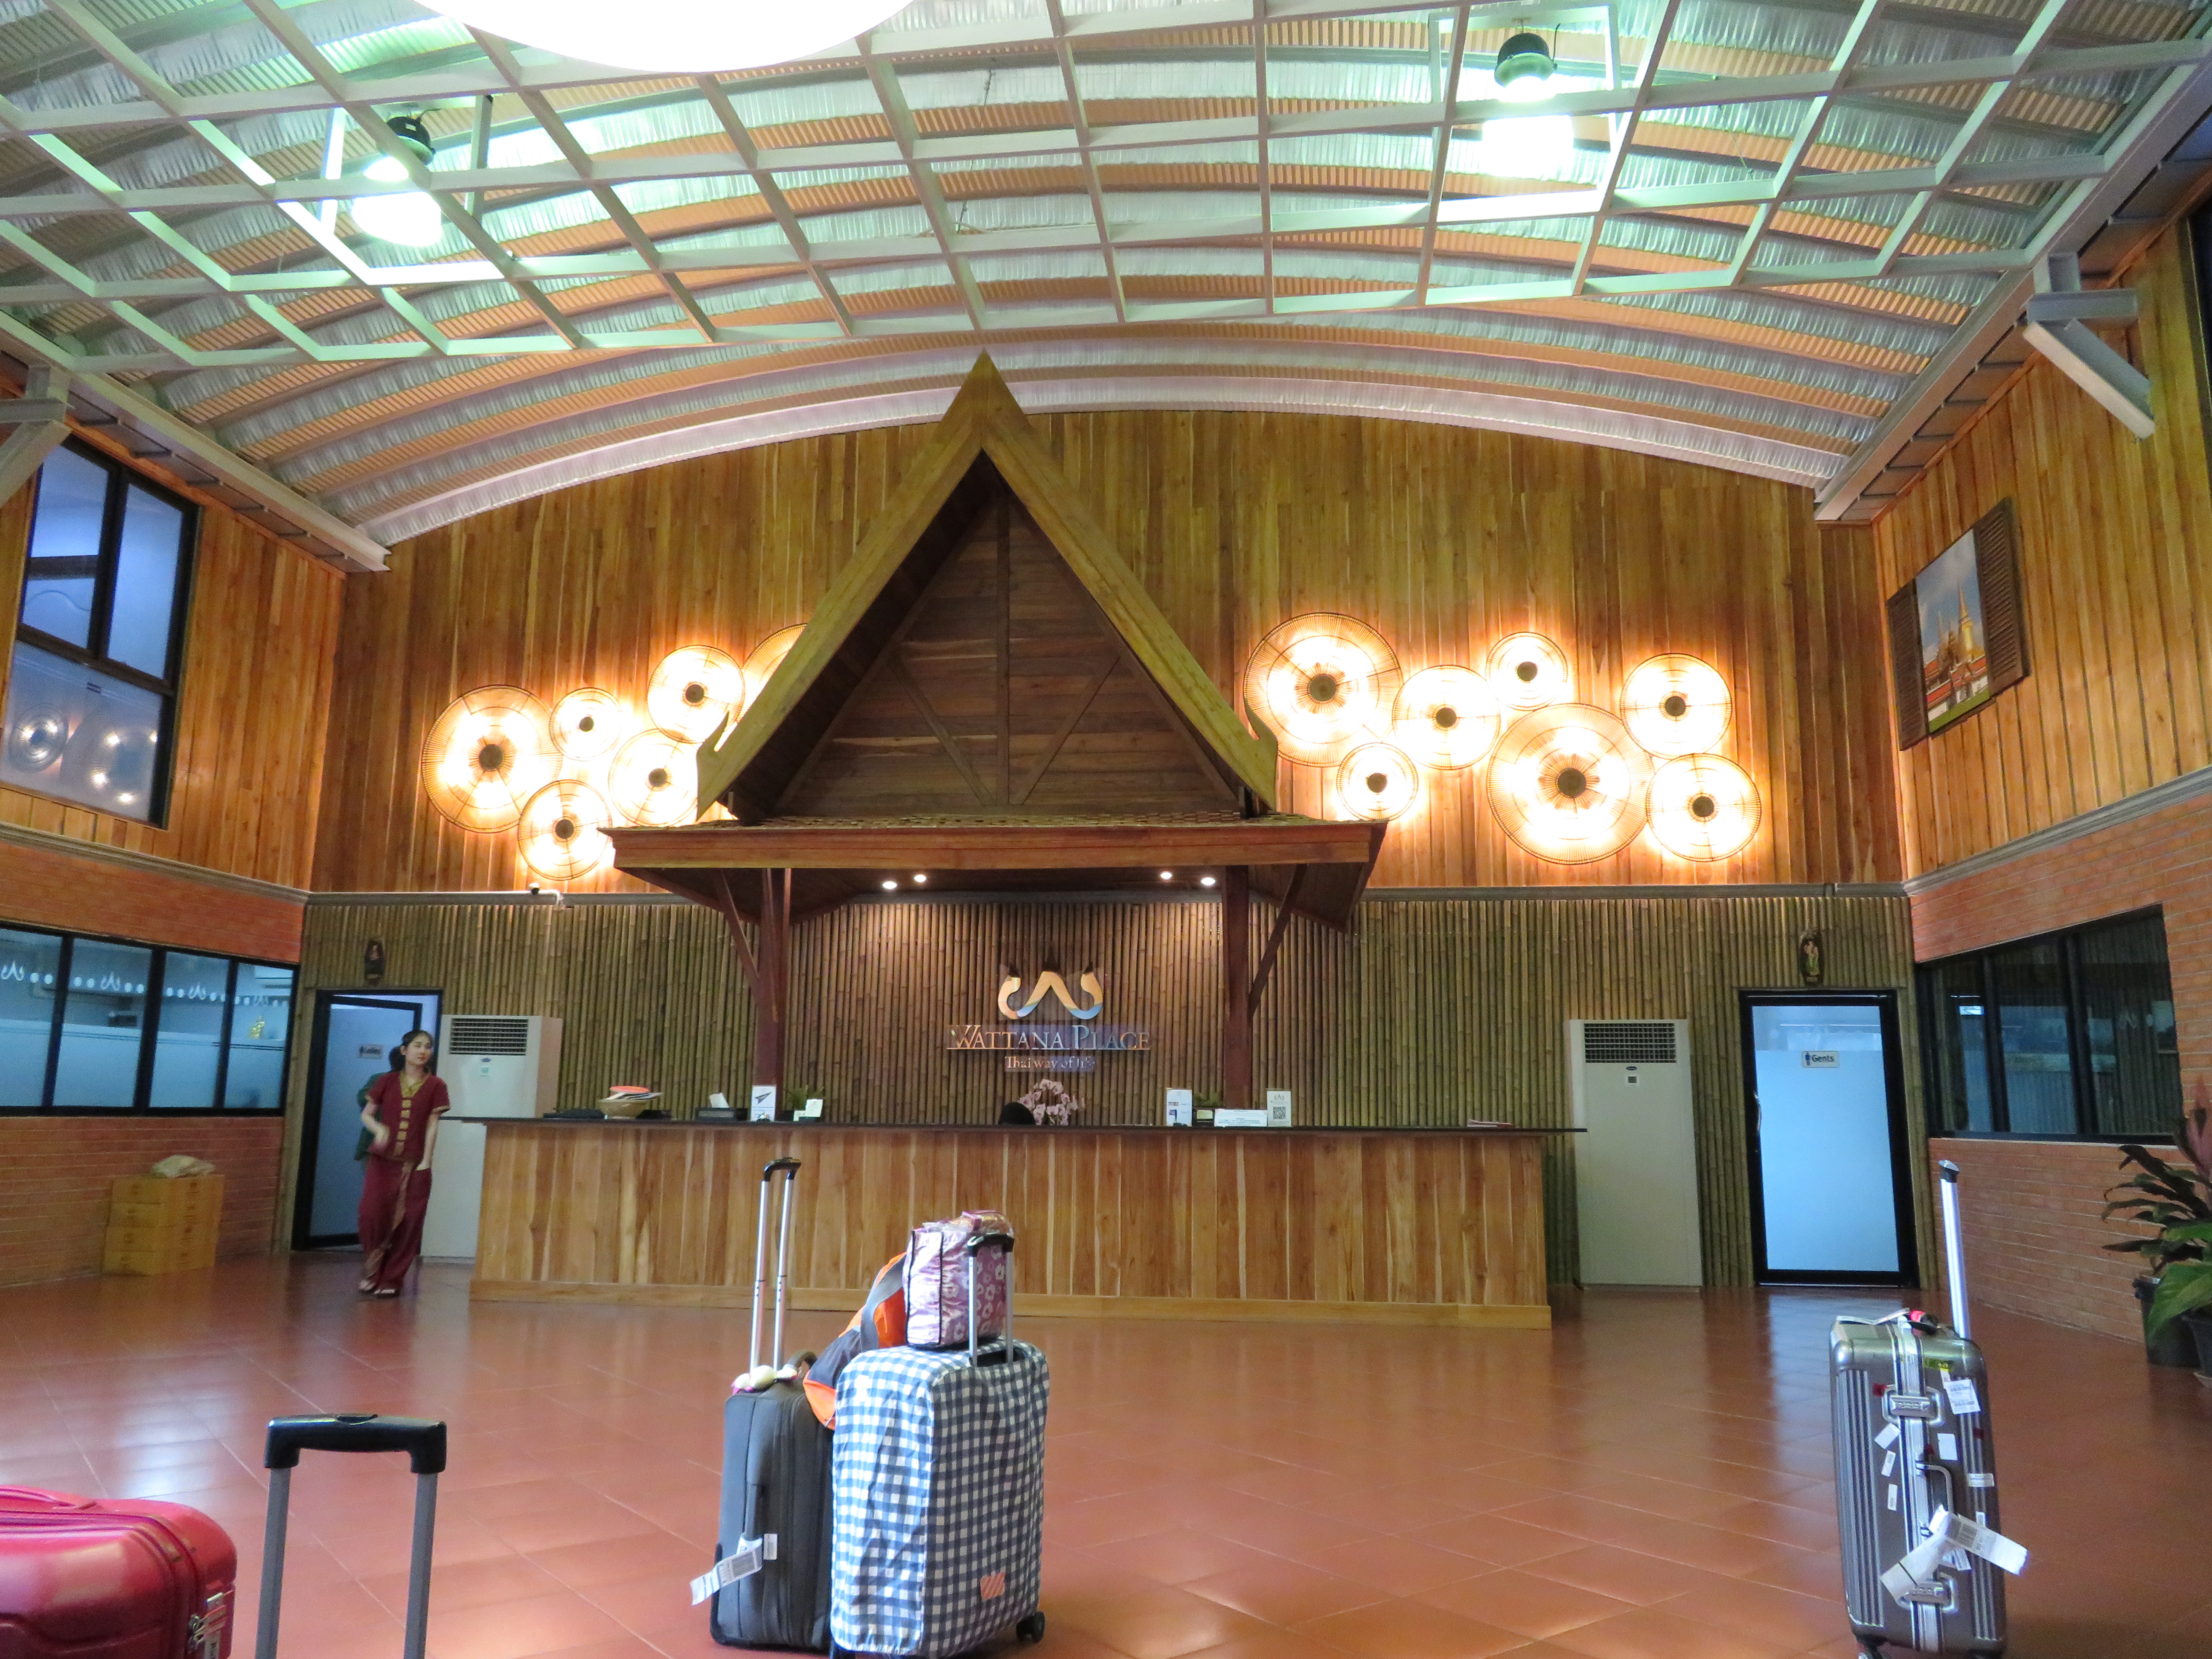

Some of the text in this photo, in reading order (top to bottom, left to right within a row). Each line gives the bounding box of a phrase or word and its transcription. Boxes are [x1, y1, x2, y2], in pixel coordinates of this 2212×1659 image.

[950, 1025, 1150, 1050] WATTANA PLACE
[1004, 1056, 1032, 1068] Thai
[1034, 1059, 1058, 1071] way
[1061, 1056, 1075, 1068] of
